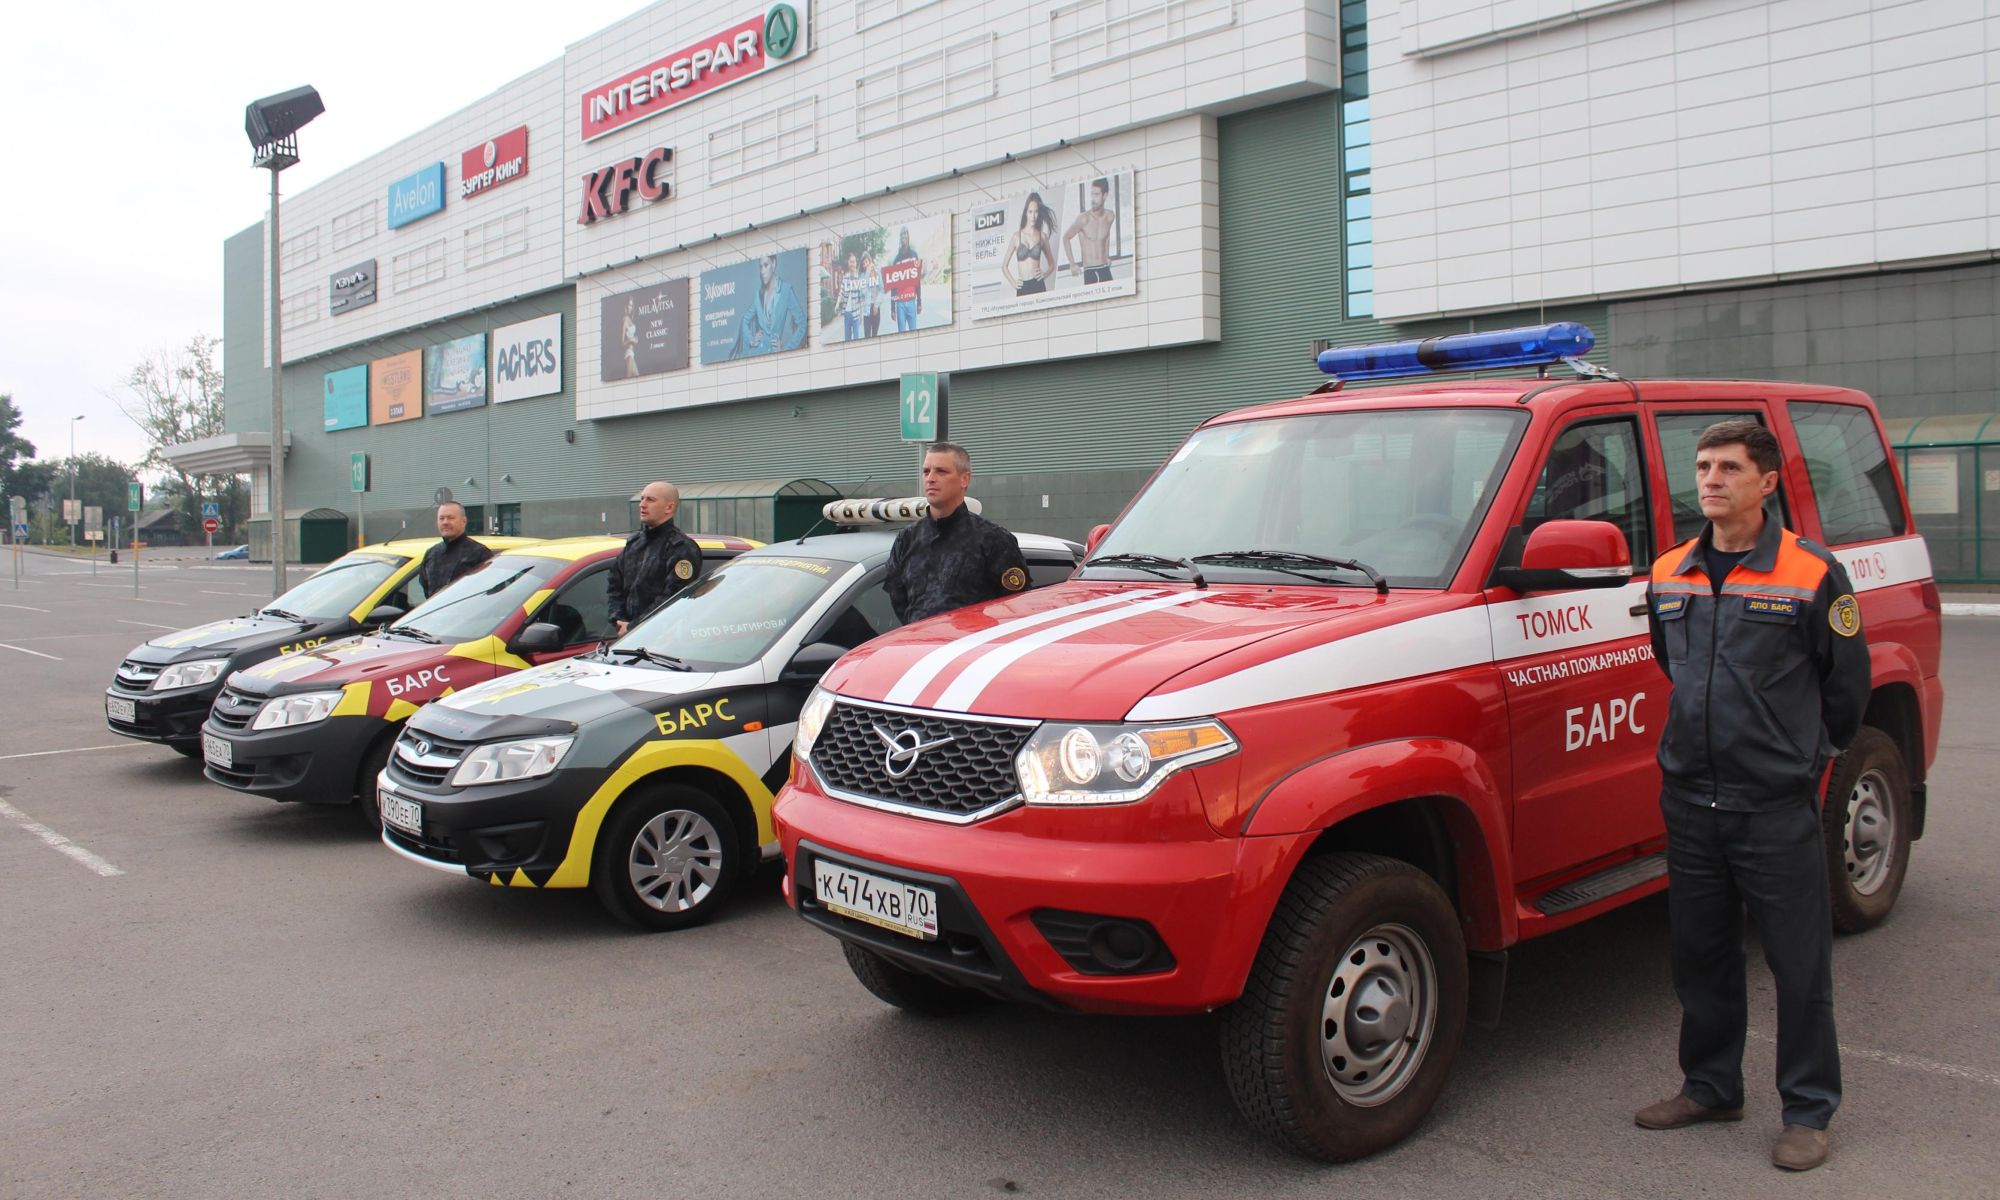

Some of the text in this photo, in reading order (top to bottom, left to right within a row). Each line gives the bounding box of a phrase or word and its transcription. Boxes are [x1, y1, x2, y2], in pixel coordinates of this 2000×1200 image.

[589, 29, 759, 124] INTERSPAR
[461, 156, 522, 198] БУРГЕР КИНГ
[577, 147, 673, 227] KFC
[393, 173, 435, 216] Avelon
[977, 212, 1000, 229] DIM
[975, 235, 1005, 249] НИЖНЕЕ
[639, 297, 674, 315] MILAVITSA
[646, 328, 668, 339] CLASSIC
[650, 319, 663, 328] NEW
[906, 390, 930, 424] 12
[353, 461, 362, 481] 13
[130, 490, 138, 503] 14
[1851, 557, 1873, 580] 101
[1749, 601, 1793, 613] ДПО БАРС
[1516, 604, 1593, 640] ТОМСК
[1508, 644, 1655, 687] ЧАСТНАЯ ПОЖАРНАЯ ОХ
[386, 664, 451, 697] БАРС
[655, 697, 736, 736] БАРС
[1565, 692, 1646, 752] БАРС
[411, 805, 420, 823] 70
[823, 872, 901, 918] К474ХВ
[906, 888, 928, 917] 70
[907, 913, 924, 927] RUS
